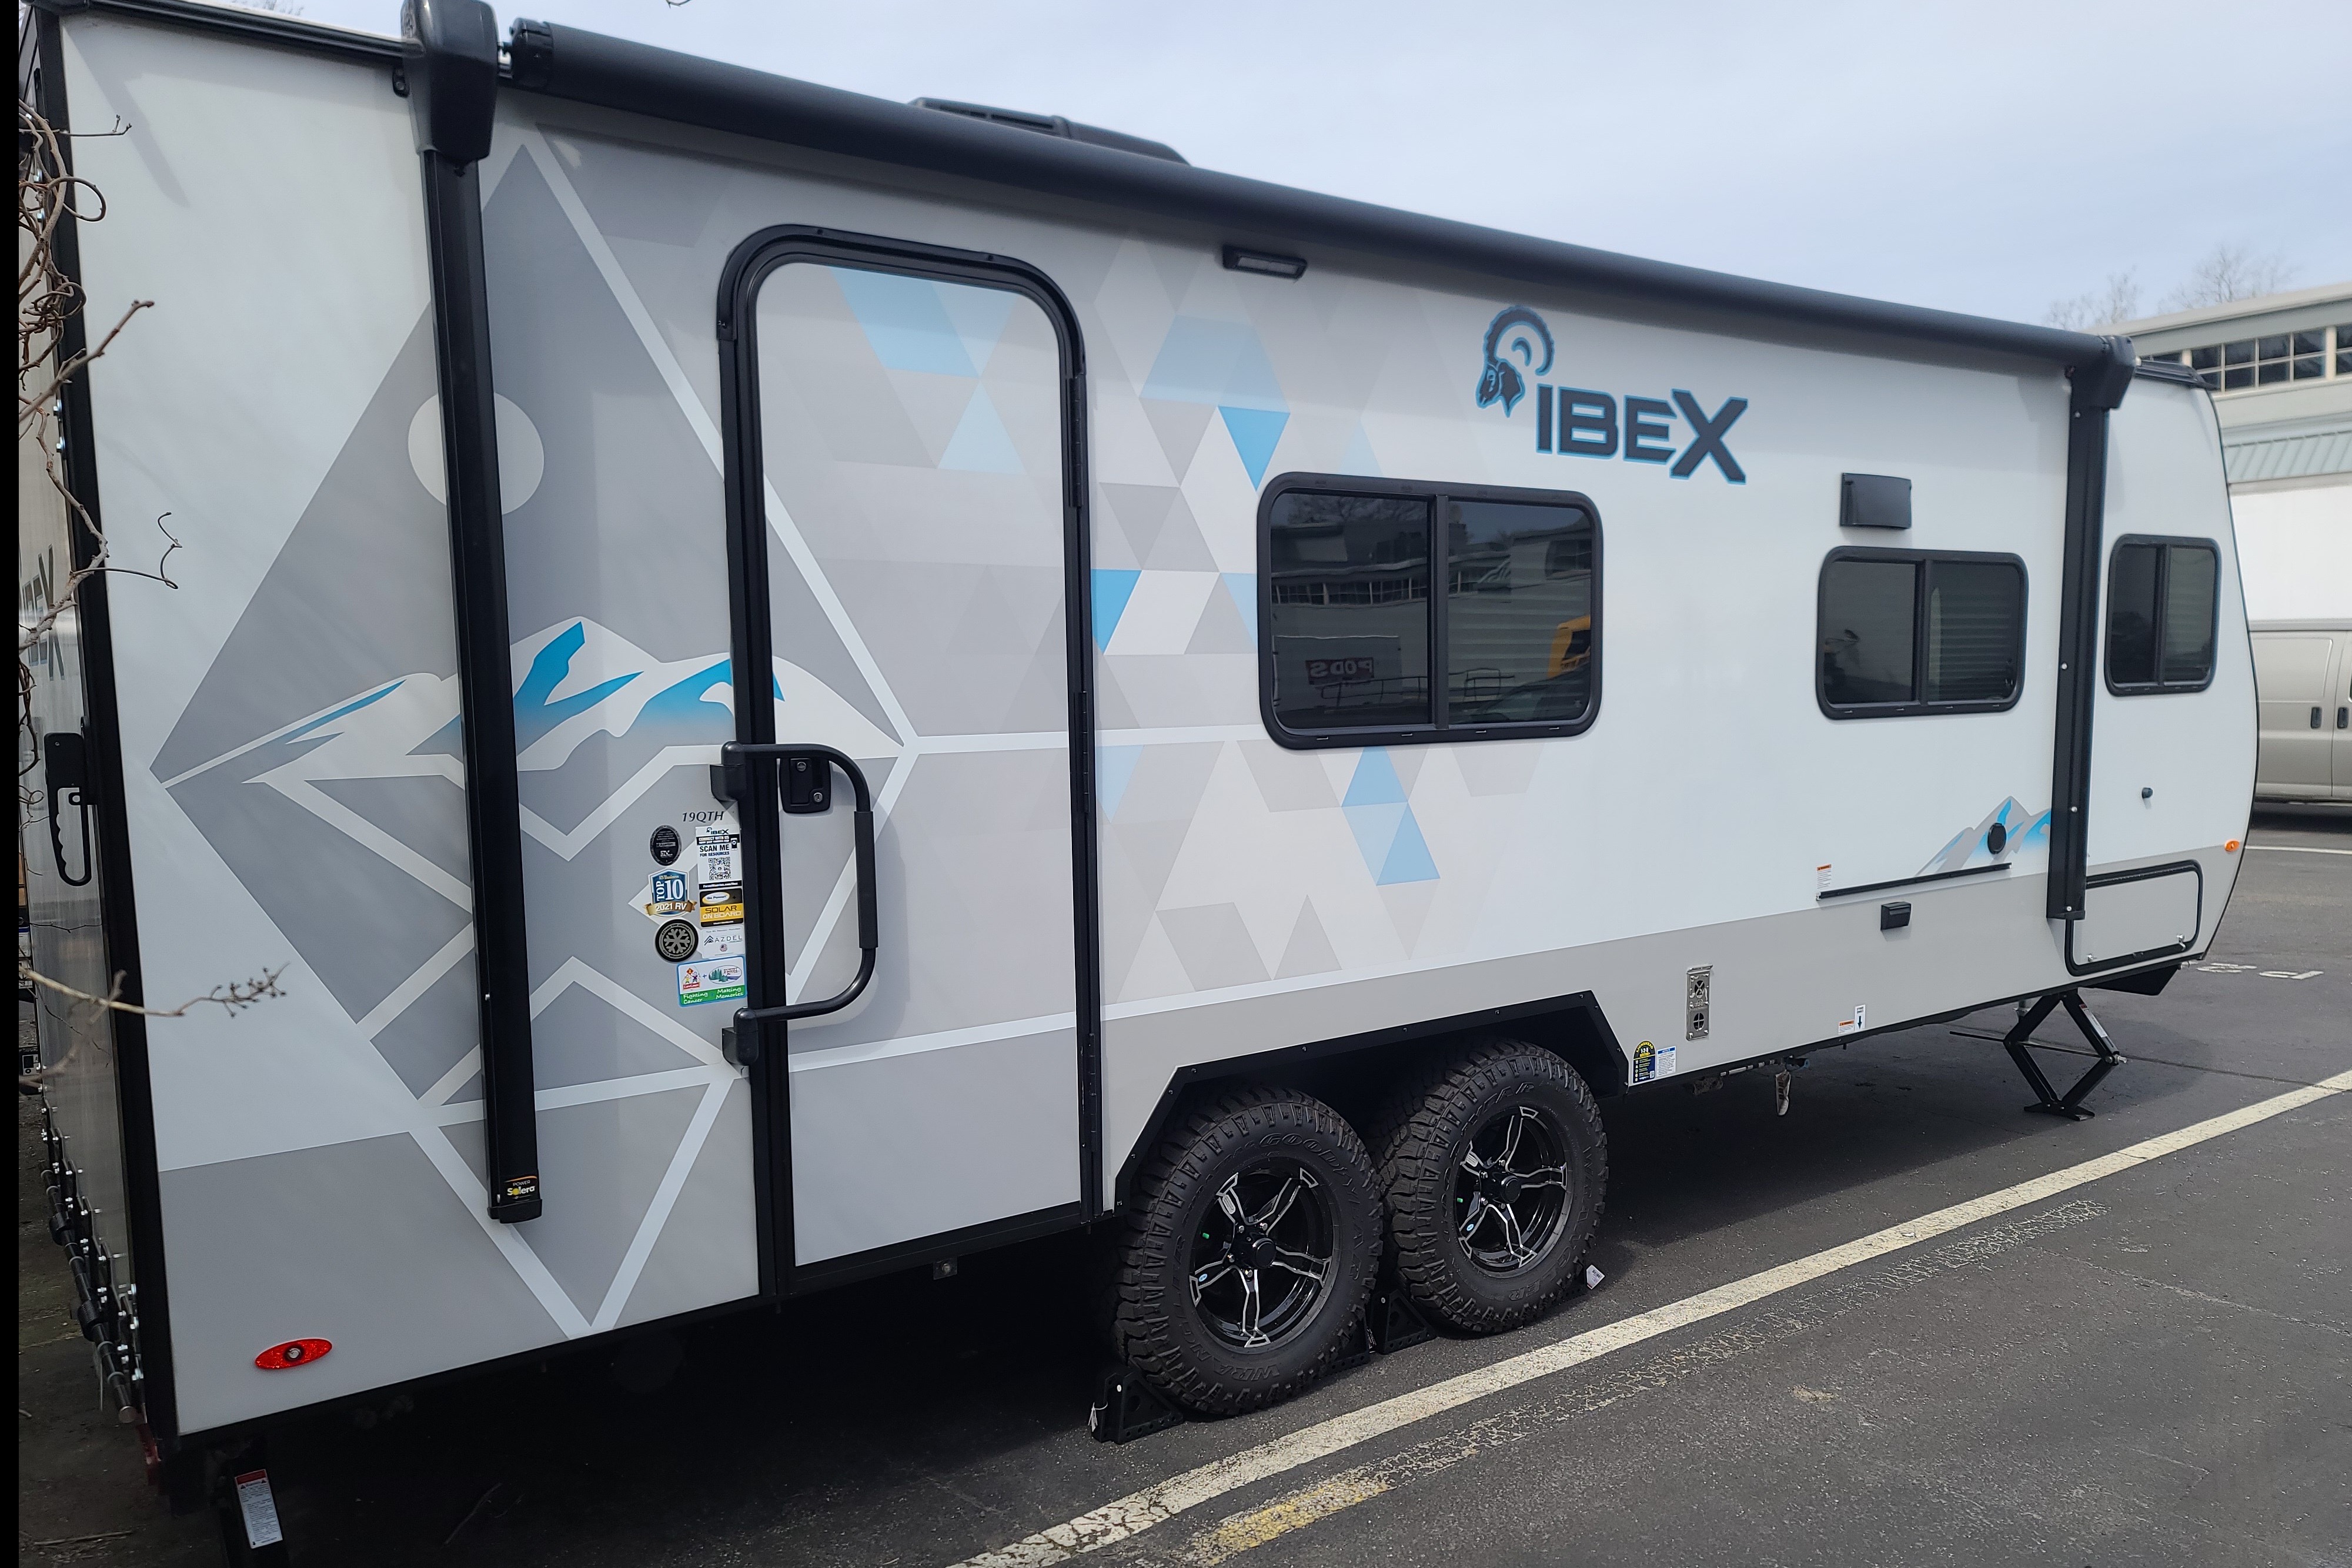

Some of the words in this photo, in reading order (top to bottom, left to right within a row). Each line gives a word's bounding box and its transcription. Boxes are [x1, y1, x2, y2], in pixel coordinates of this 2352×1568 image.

[1536, 383, 1748, 485] IBEX
[682, 811, 724, 823] 19QTH
[656, 881, 665, 901] TOP
[664, 879, 684, 900] 10
[655, 903, 673, 912] 2021
[705, 905, 737, 914] SOLAR
